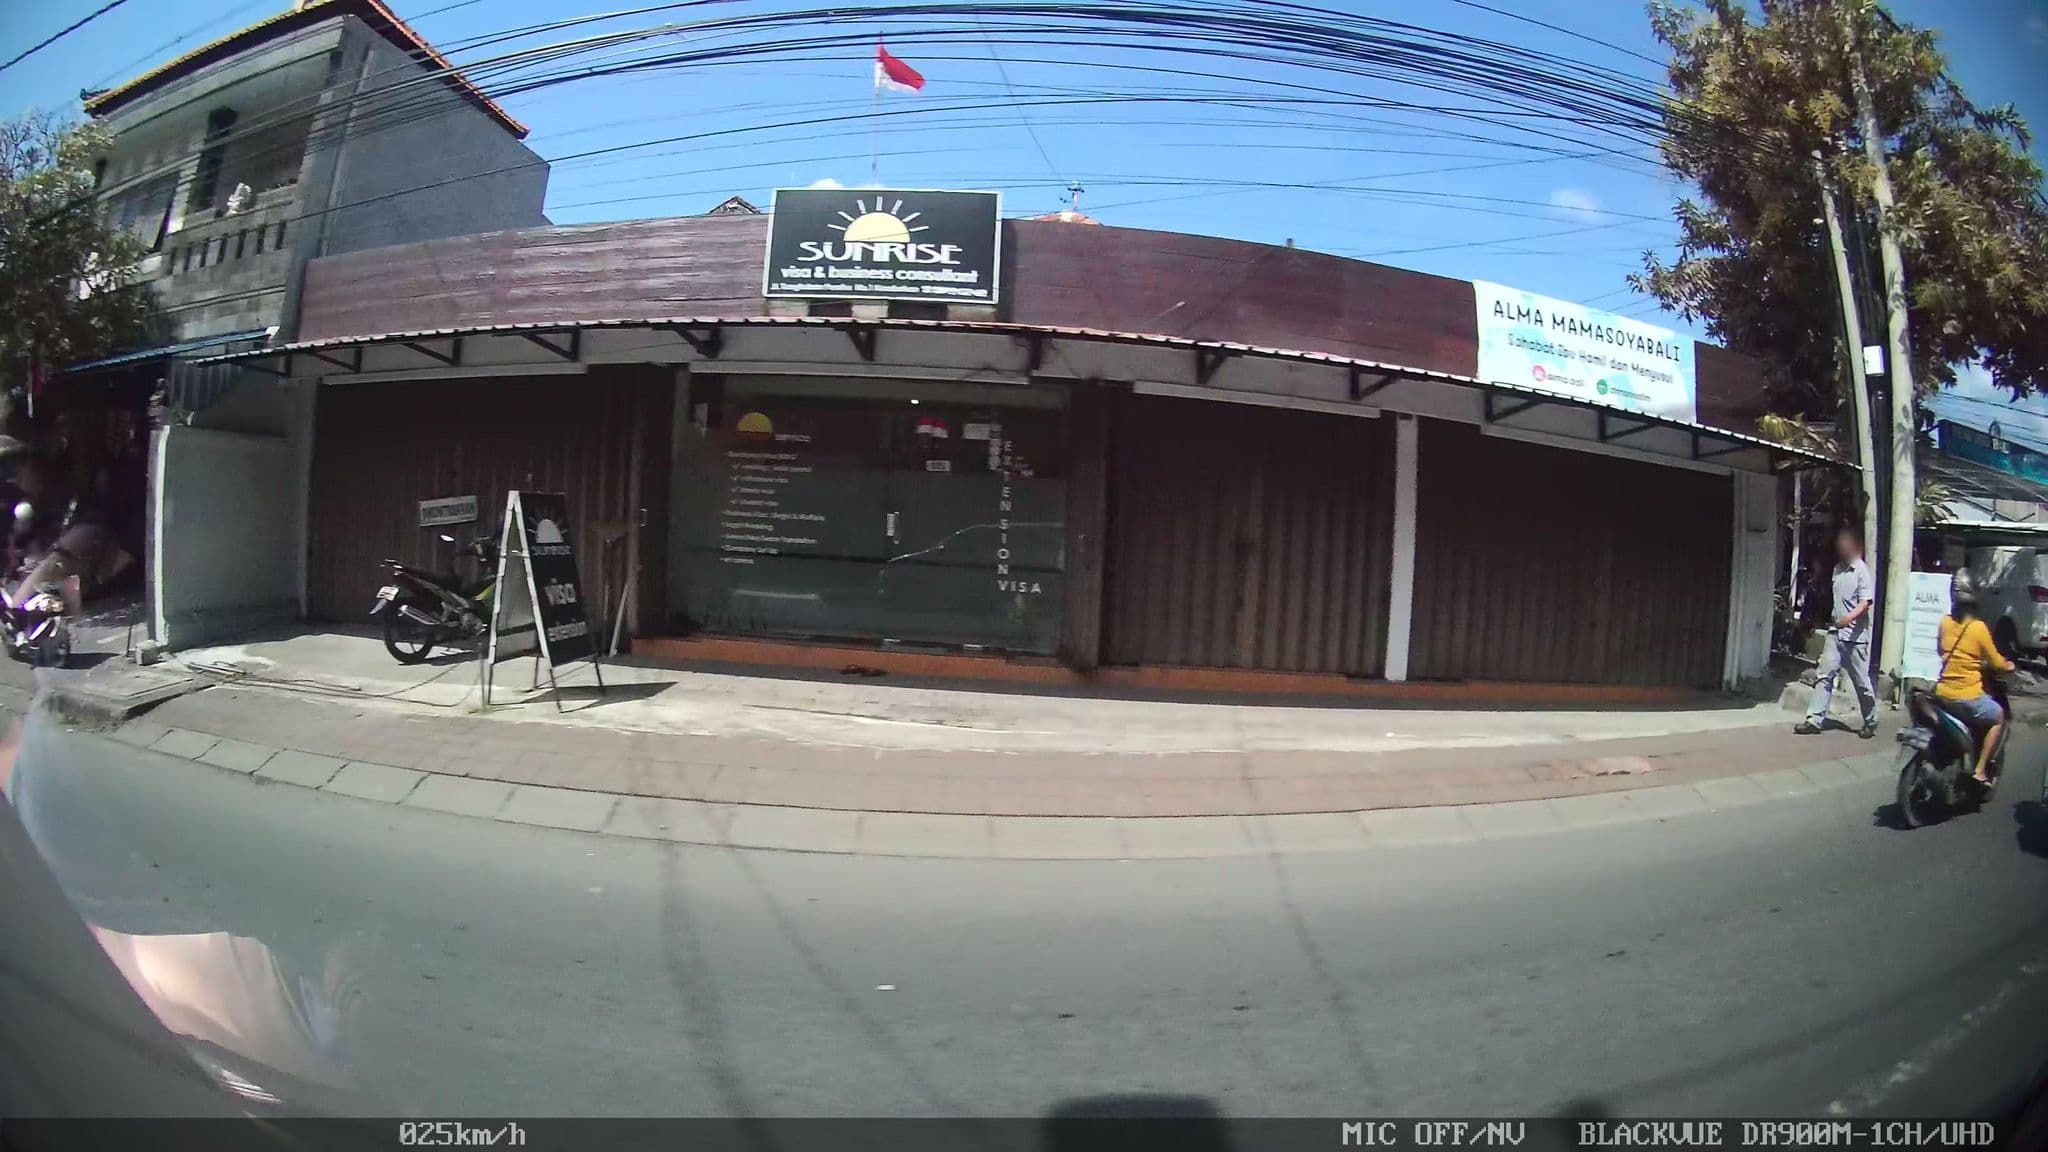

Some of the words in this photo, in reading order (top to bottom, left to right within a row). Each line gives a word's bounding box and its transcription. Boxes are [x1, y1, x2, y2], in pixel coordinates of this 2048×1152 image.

[797, 241, 963, 265] SUNRISE
[780, 265, 812, 279] visa
[813, 267, 826, 279] &
[828, 265, 894, 280] business
[895, 269, 979, 284] consultant
[1494, 299, 1544, 327] ALMA
[1551, 313, 1681, 362] MAMASOYABALI
[1507, 332, 1555, 355] Sahabat
[1609, 357, 1629, 372] dan
[544, 577, 577, 606] visa
[998, 579, 1042, 594] VISA
[1915, 591, 1939, 604] ALMA
